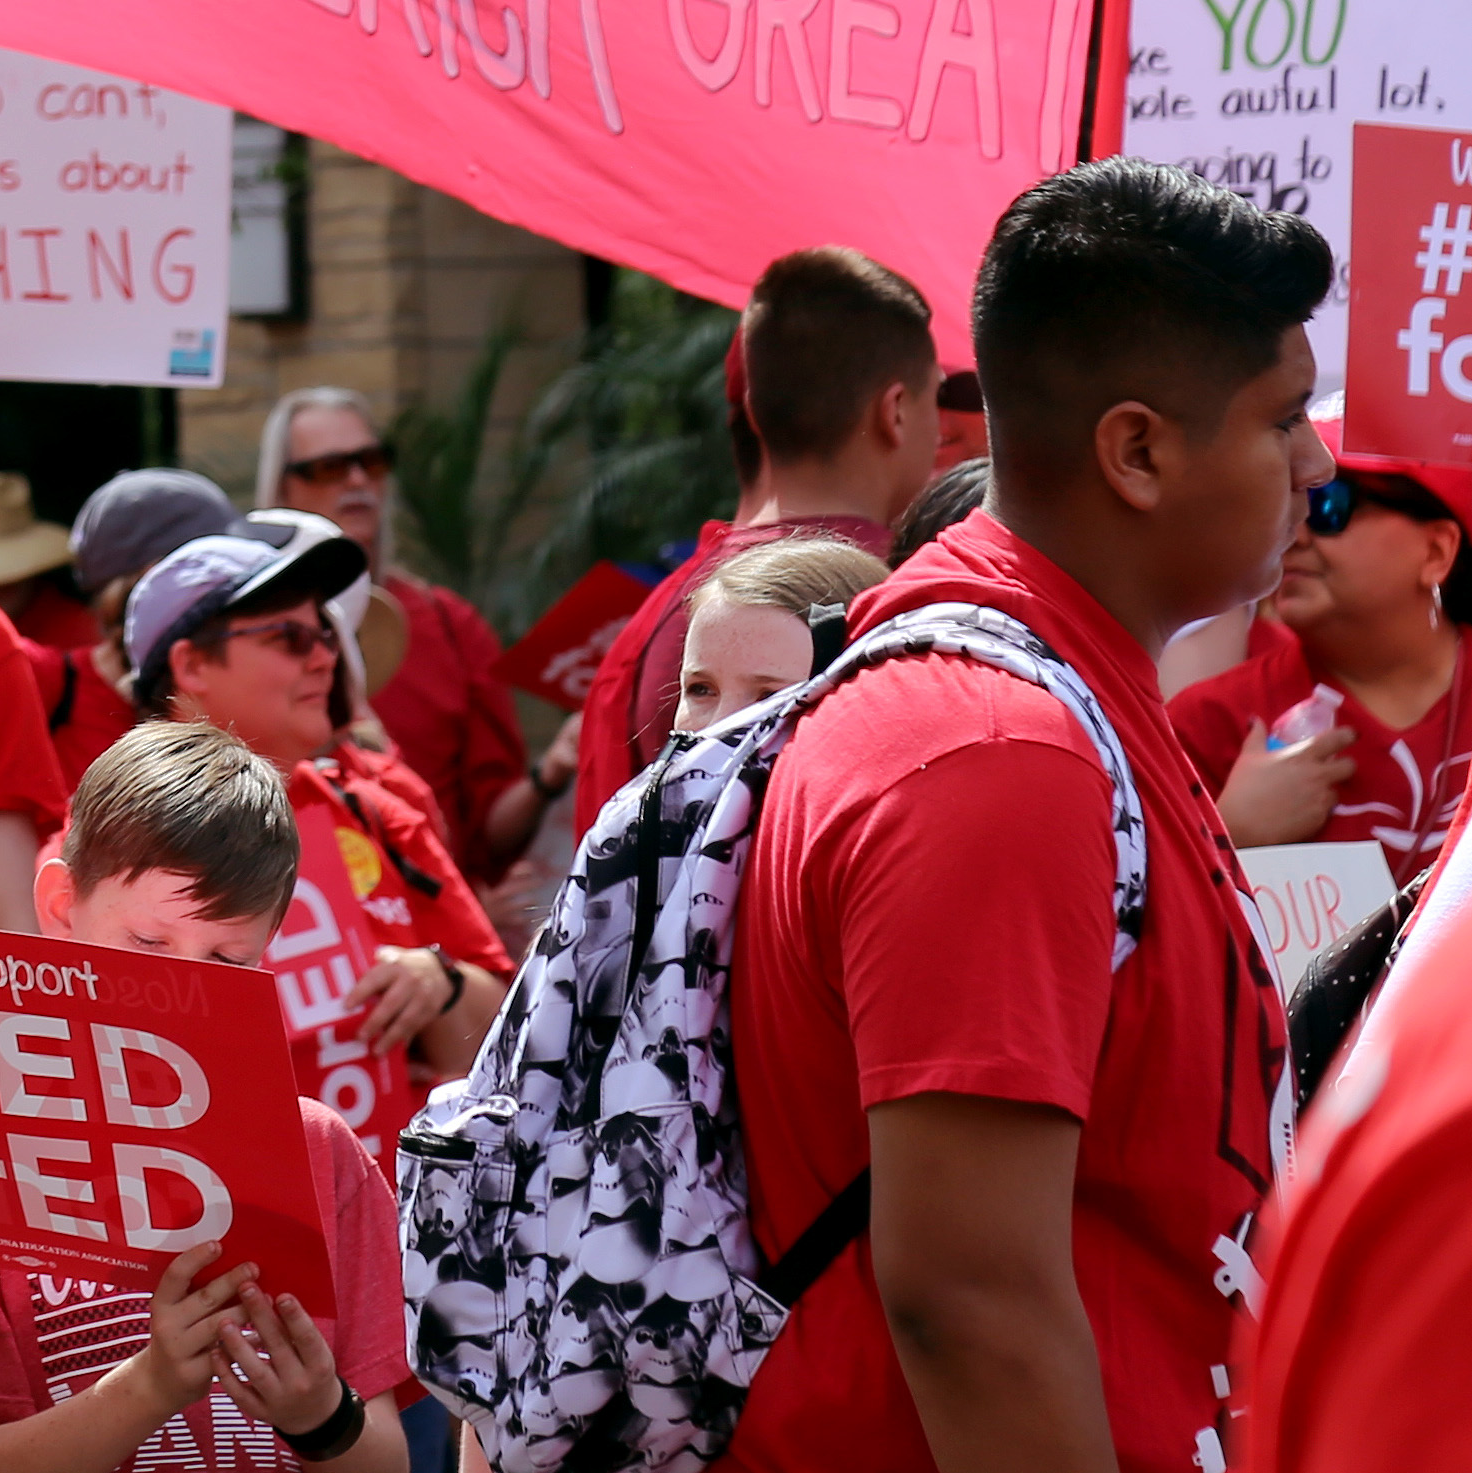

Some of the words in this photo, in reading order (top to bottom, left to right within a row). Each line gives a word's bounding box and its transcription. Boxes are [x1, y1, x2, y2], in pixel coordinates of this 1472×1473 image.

[1221, 62, 1338, 116] awful
[1378, 65, 1446, 113] lot.
[58, 149, 193, 194] about
[1296, 134, 1333, 184] to
